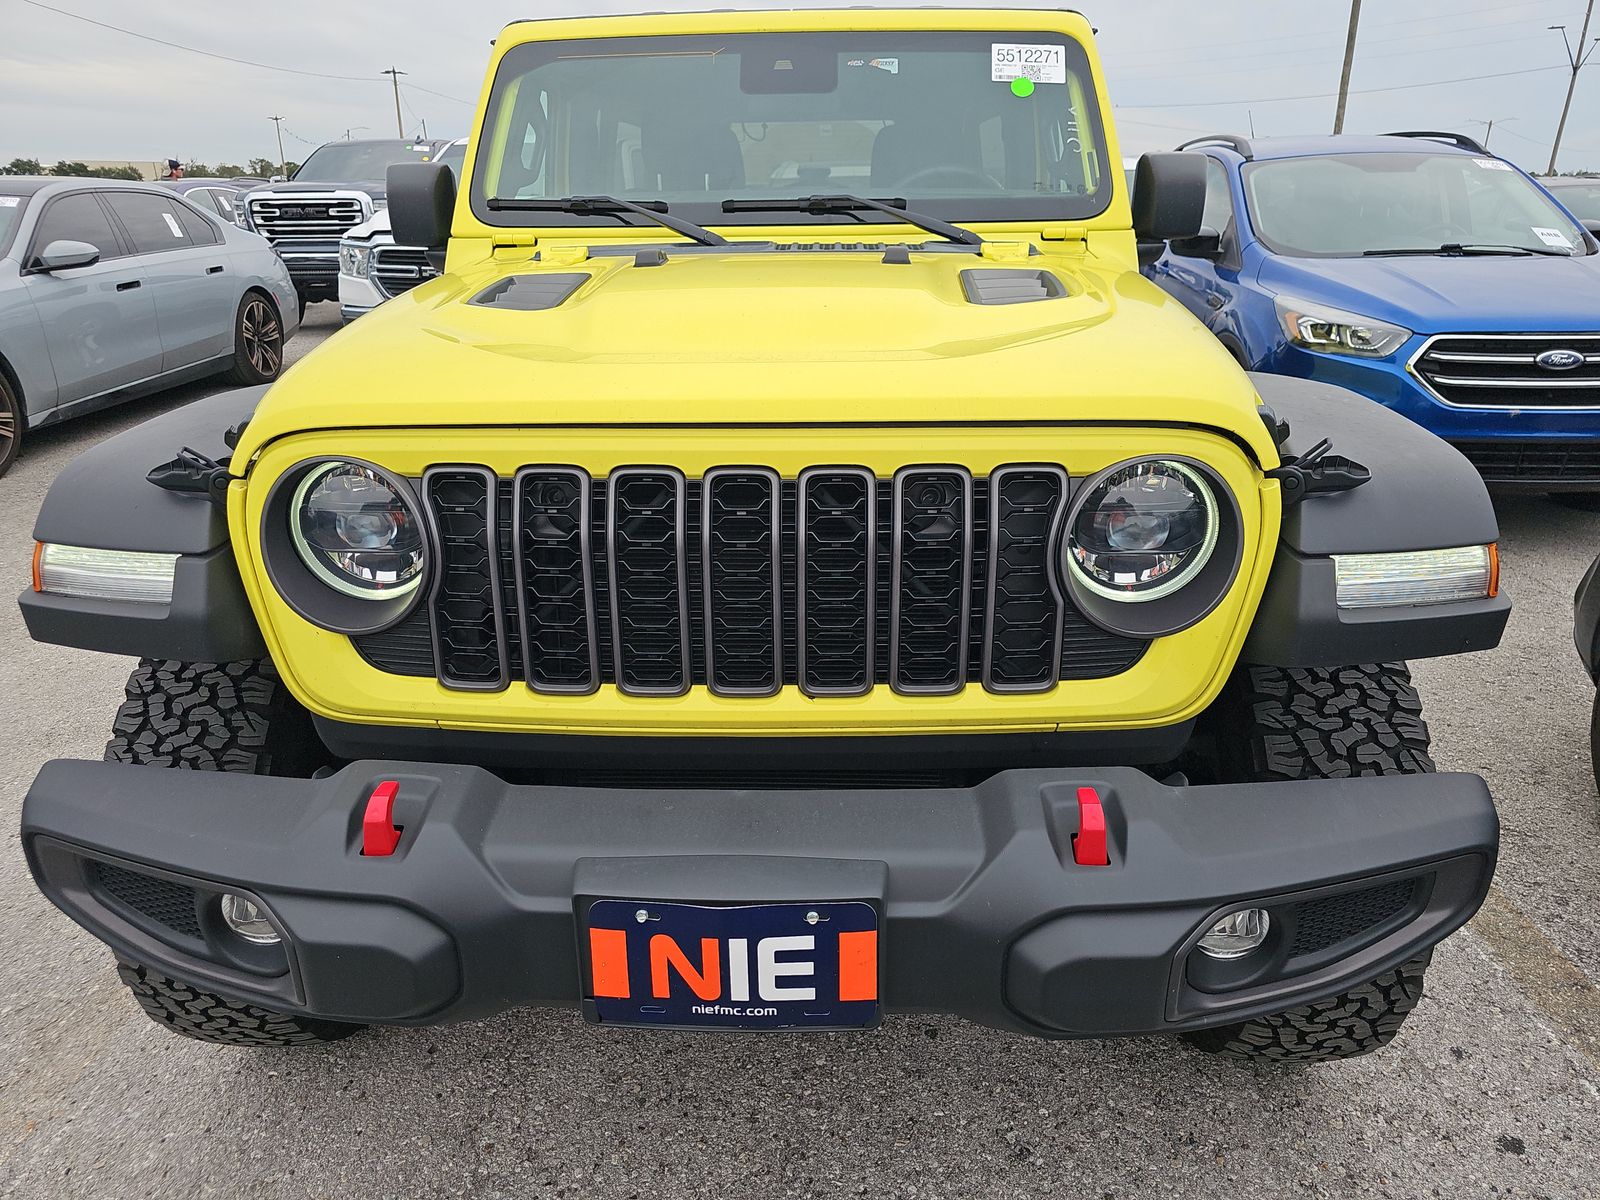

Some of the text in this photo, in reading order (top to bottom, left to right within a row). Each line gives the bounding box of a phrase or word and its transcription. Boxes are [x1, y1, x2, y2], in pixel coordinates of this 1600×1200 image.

[996, 48, 1060, 64] 5512271
[281, 207, 329, 218] GMC
[1548, 354, 1574, 365] Ford
[649, 934, 816, 1001] NIE
[692, 1004, 777, 1017] niefmc.com
